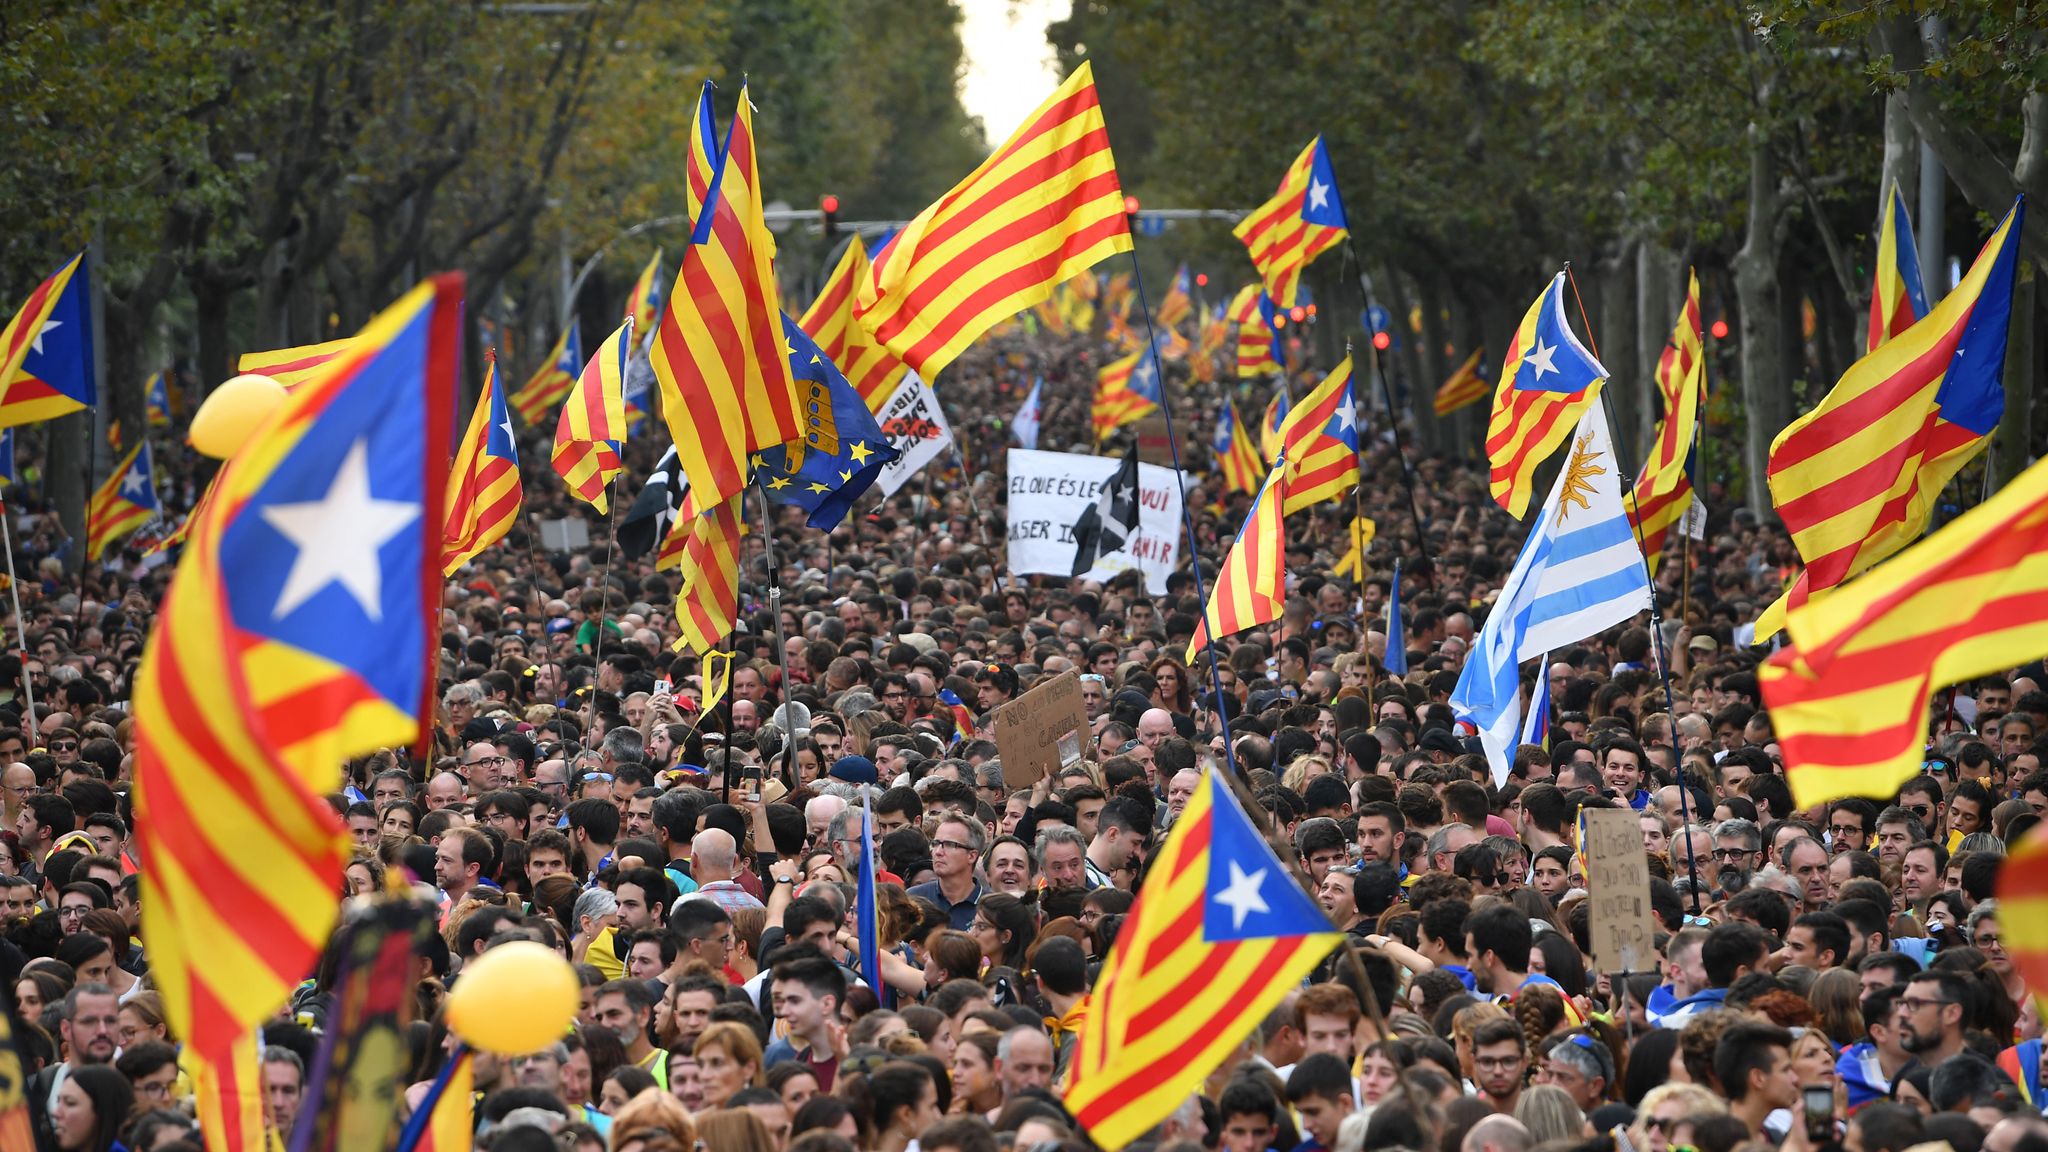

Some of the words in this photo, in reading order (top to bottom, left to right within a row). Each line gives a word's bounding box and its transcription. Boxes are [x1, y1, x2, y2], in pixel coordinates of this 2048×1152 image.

[1011, 475, 1026, 494] EL
[1029, 476, 1056, 494] QUE
[1078, 480, 1100, 498] LE
